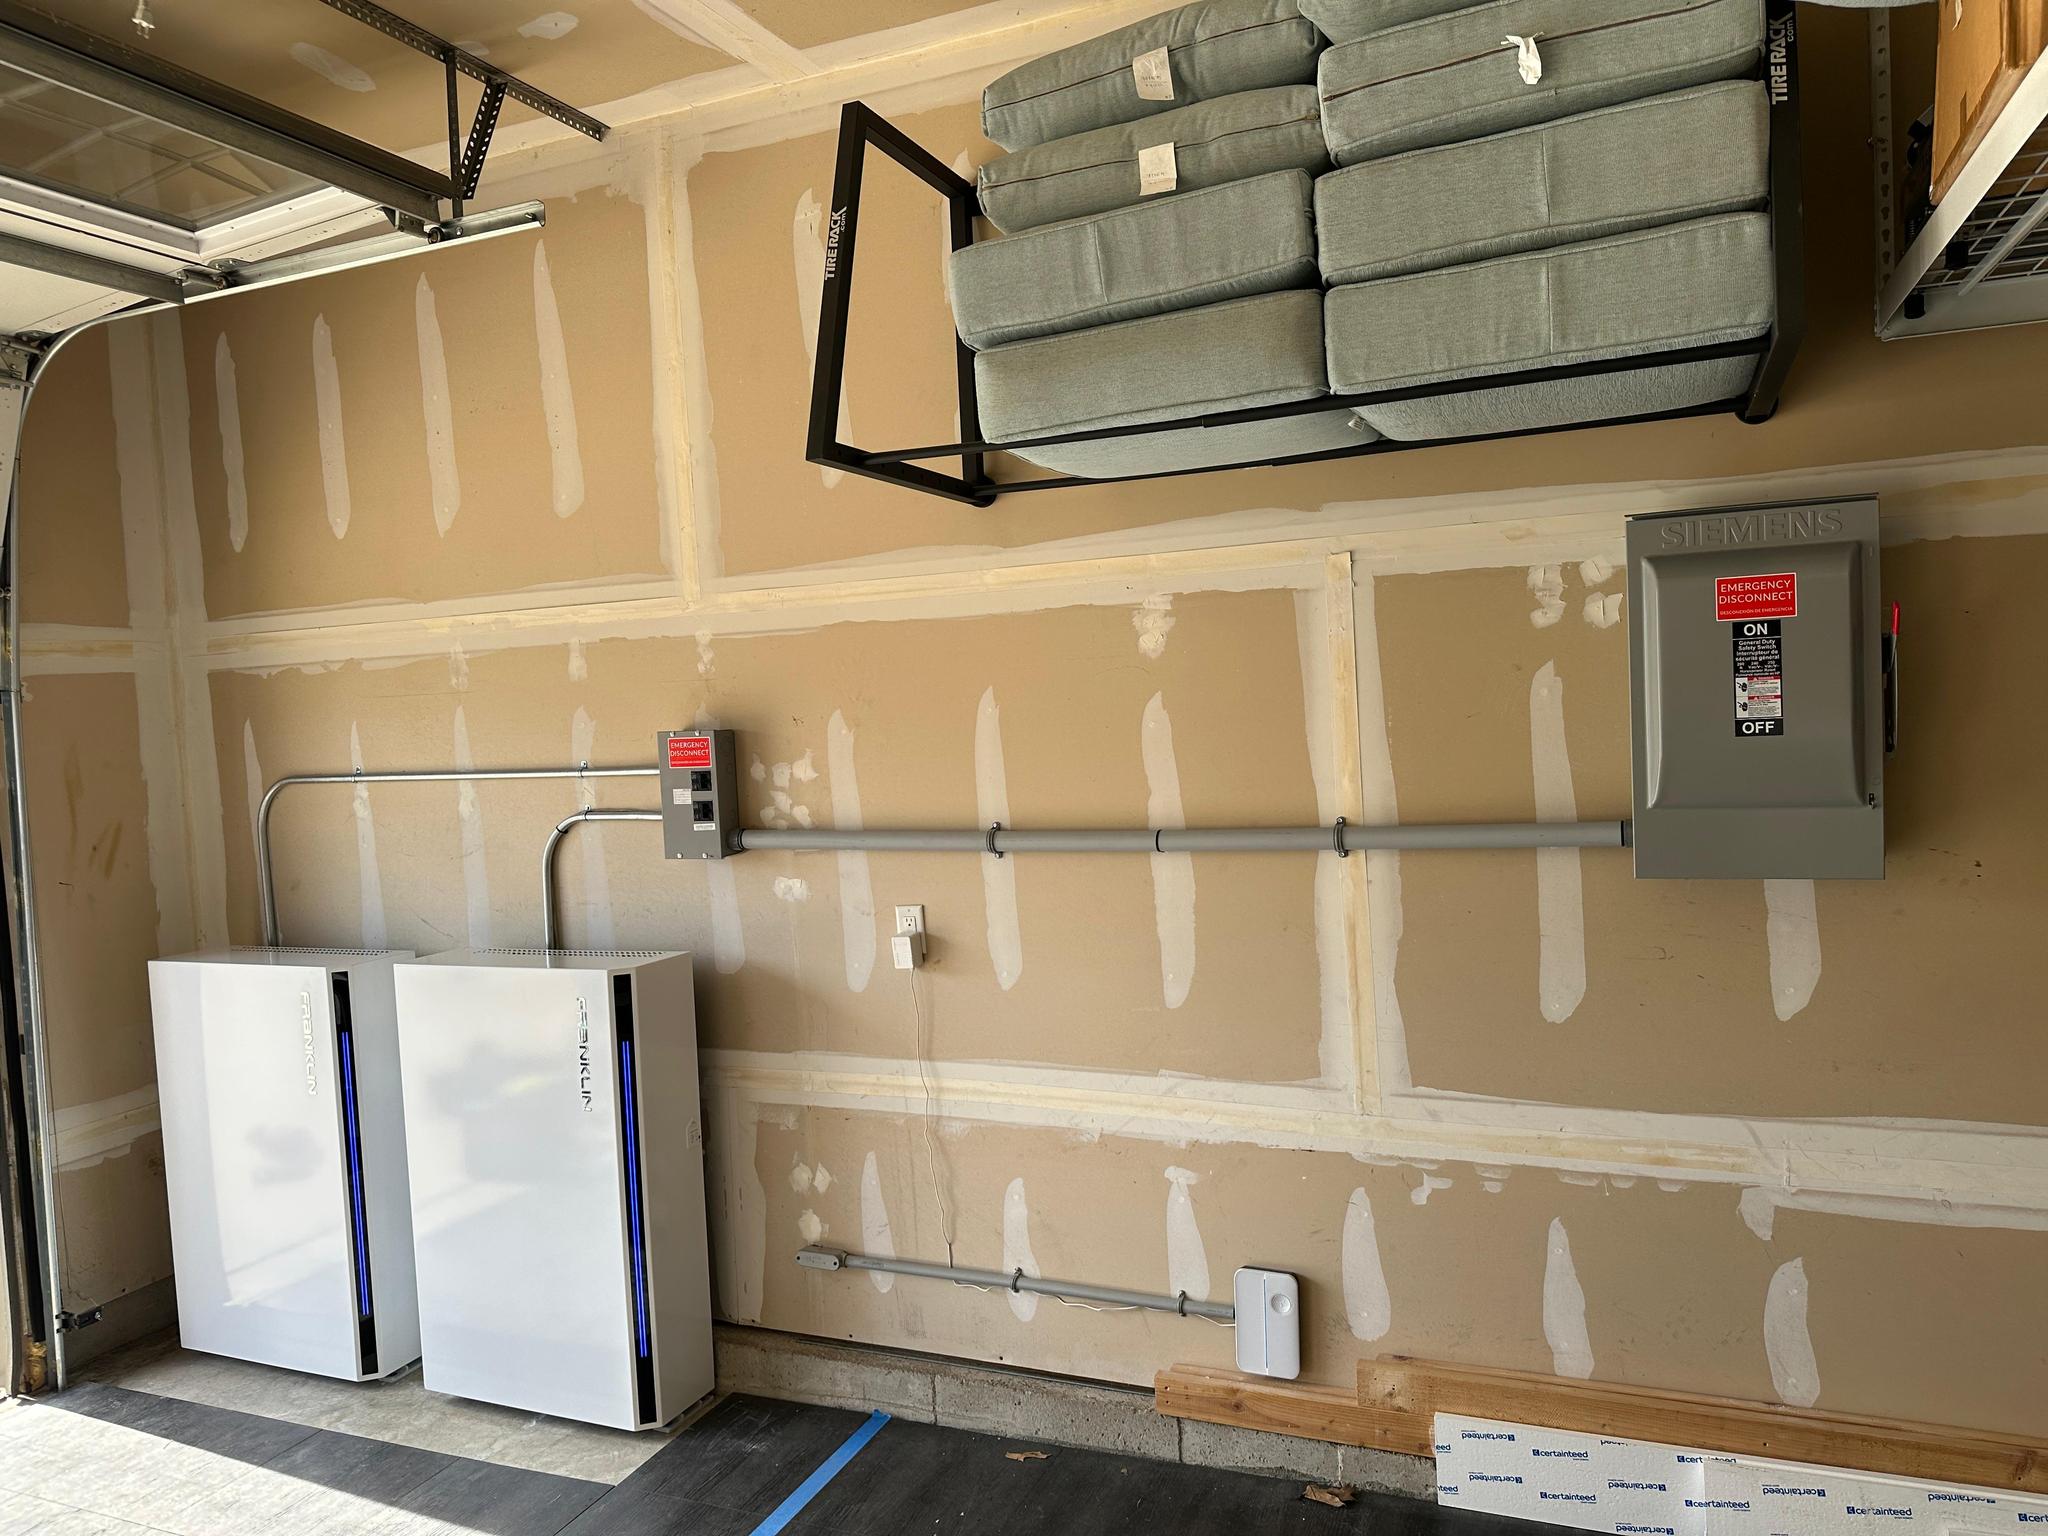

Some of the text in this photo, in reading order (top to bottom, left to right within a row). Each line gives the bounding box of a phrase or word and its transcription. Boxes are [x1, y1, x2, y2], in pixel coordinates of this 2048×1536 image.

[1661, 508, 1844, 548] SIEMENS
[1720, 578, 1791, 593] EMERGENCY
[1719, 591, 1793, 605] DISCONNECT
[1743, 623, 1768, 636] ON
[1742, 721, 1775, 734] OFF
[670, 741, 708, 749] EMERGENCY
[670, 749, 709, 757] DISCONNECT
[300, 991, 318, 1096] FRANKLIN
[1461, 1432, 1508, 1440] certainteed
[1540, 1449, 1589, 1458] certainteed
[1468, 1474, 1515, 1482] certainteed
[1607, 1481, 1658, 1490] certainteed
[1762, 1487, 1817, 1495] certainteed
[1547, 1492, 1597, 1501] certainteed
[1615, 1525, 1666, 1534] certainteed
